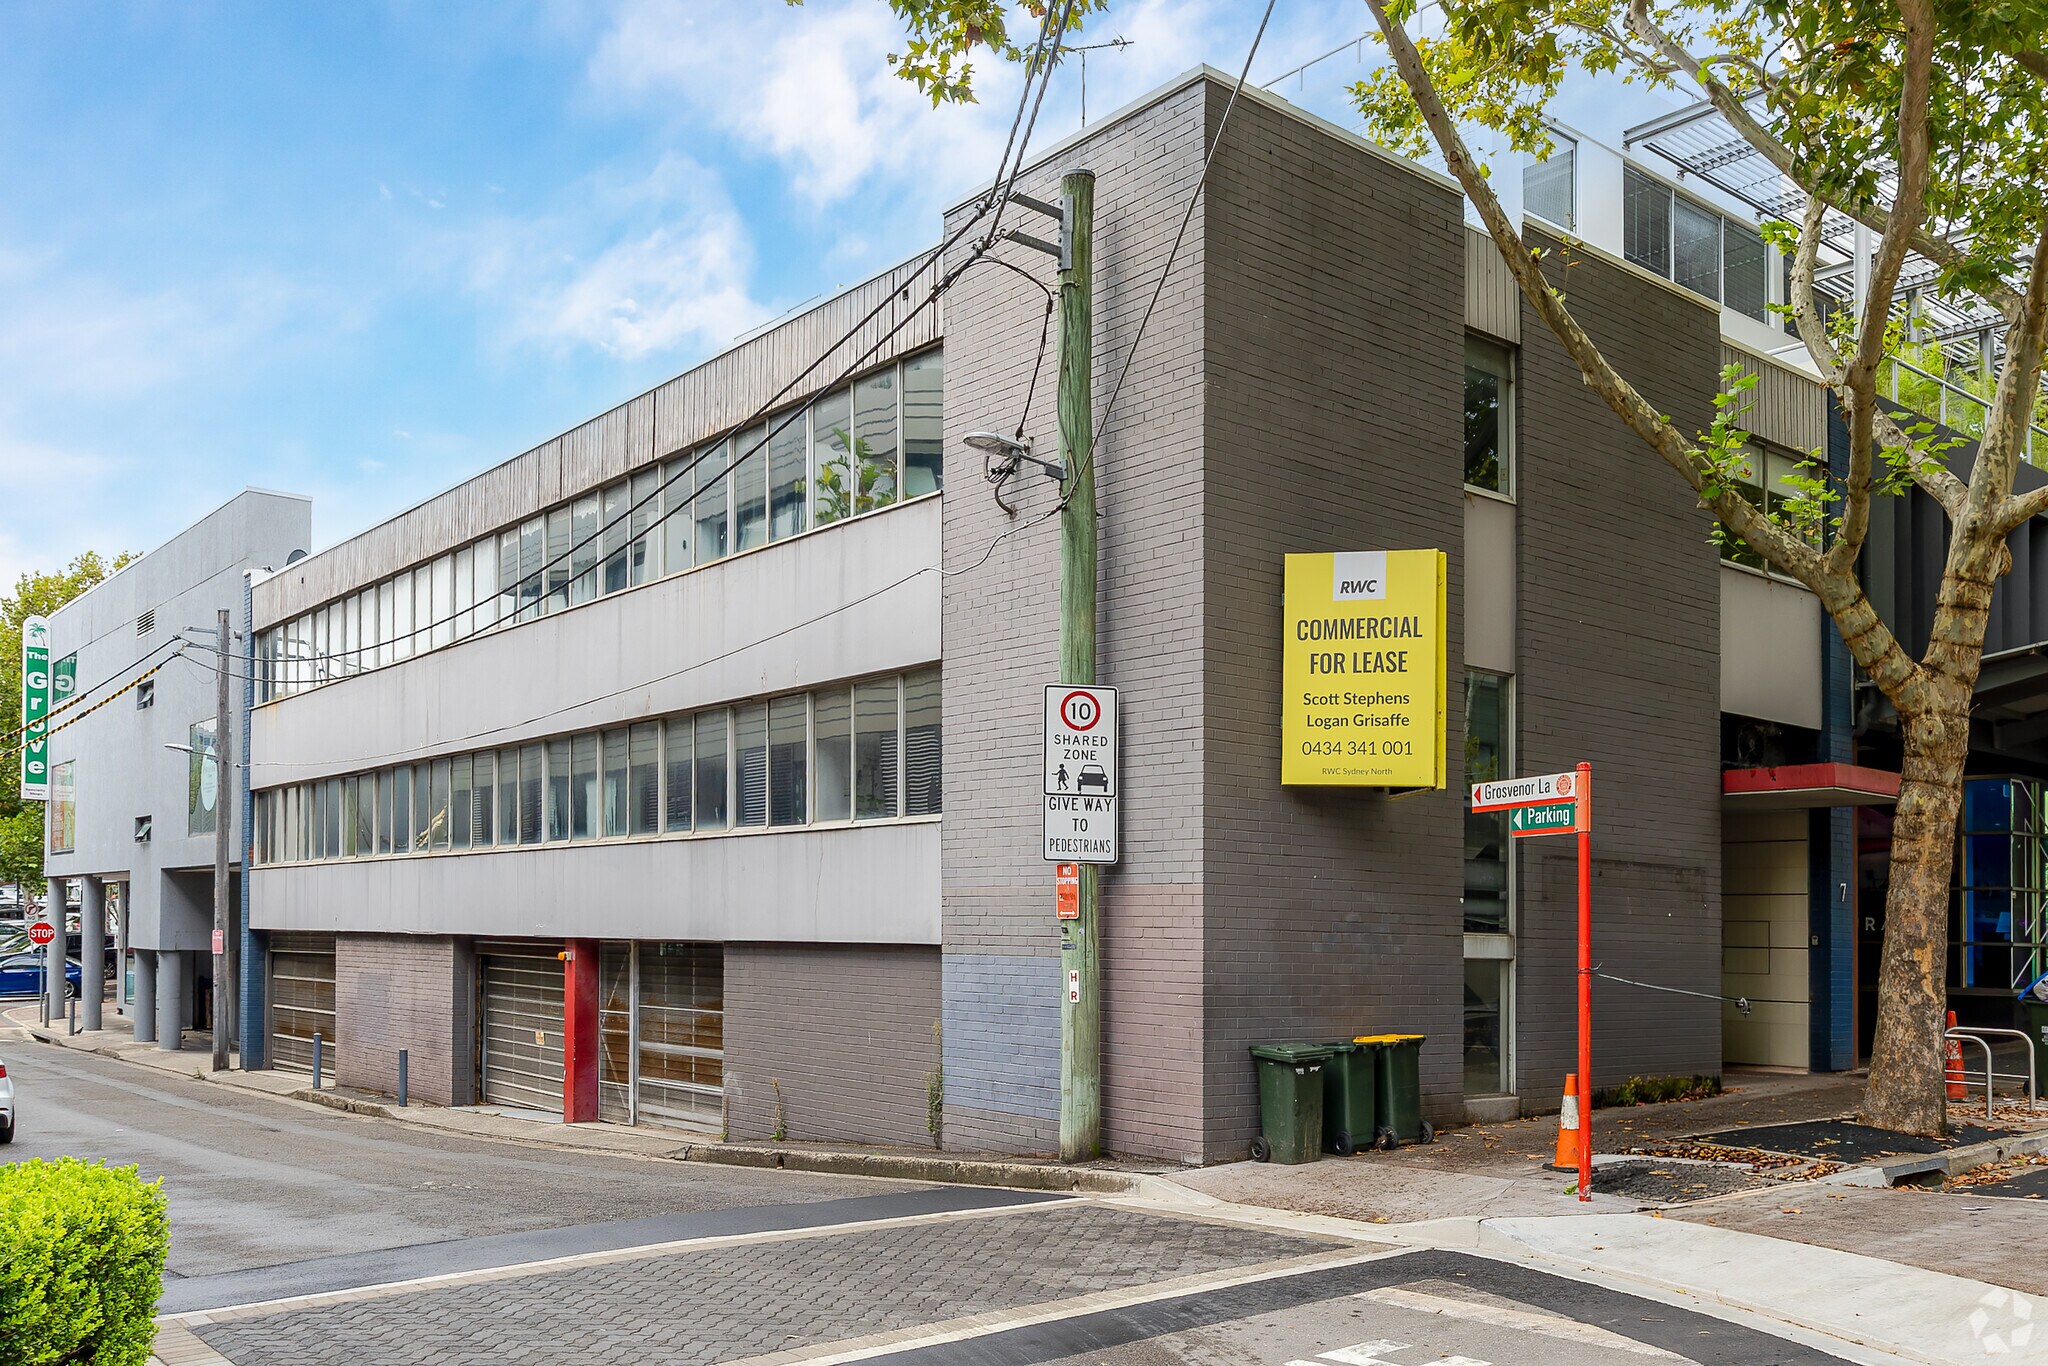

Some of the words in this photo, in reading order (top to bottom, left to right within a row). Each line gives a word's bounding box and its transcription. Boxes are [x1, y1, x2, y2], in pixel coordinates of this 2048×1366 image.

[1340, 580, 1377, 594] RWC
[1297, 616, 1423, 641] COMMERCIAL
[27, 651, 48, 661] The
[1310, 653, 1346, 675] FOR
[1353, 651, 1408, 674] LEASE
[1303, 692, 1340, 706] Scott
[1343, 692, 1410, 707] Stephens
[1071, 703, 1091, 720] 10
[27, 671, 48, 774] Grove
[1306, 714, 1349, 729] Logan
[1353, 713, 1410, 727] Grisaffe
[1054, 734, 1108, 747] SHARED
[1301, 741, 1342, 755] 0434
[1347, 741, 1377, 755] 341
[1382, 741, 1413, 755] 001
[1063, 749, 1097, 760] ZONE
[1342, 767, 1369, 777] Sydney
[1371, 767, 1393, 775] North
[1484, 783, 1535, 800] Grosvenor
[1538, 778, 1551, 794] La
[1049, 797, 1078, 811] GIVE
[1084, 798, 1112, 812] WAY
[1527, 806, 1570, 826] Parking
[1072, 818, 1088, 832] TO
[1049, 838, 1111, 853] PEDESTRIANS
[1062, 866, 1072, 876] NO
[1840, 883, 1847, 902] 7
[30, 929, 54, 938] STOP
